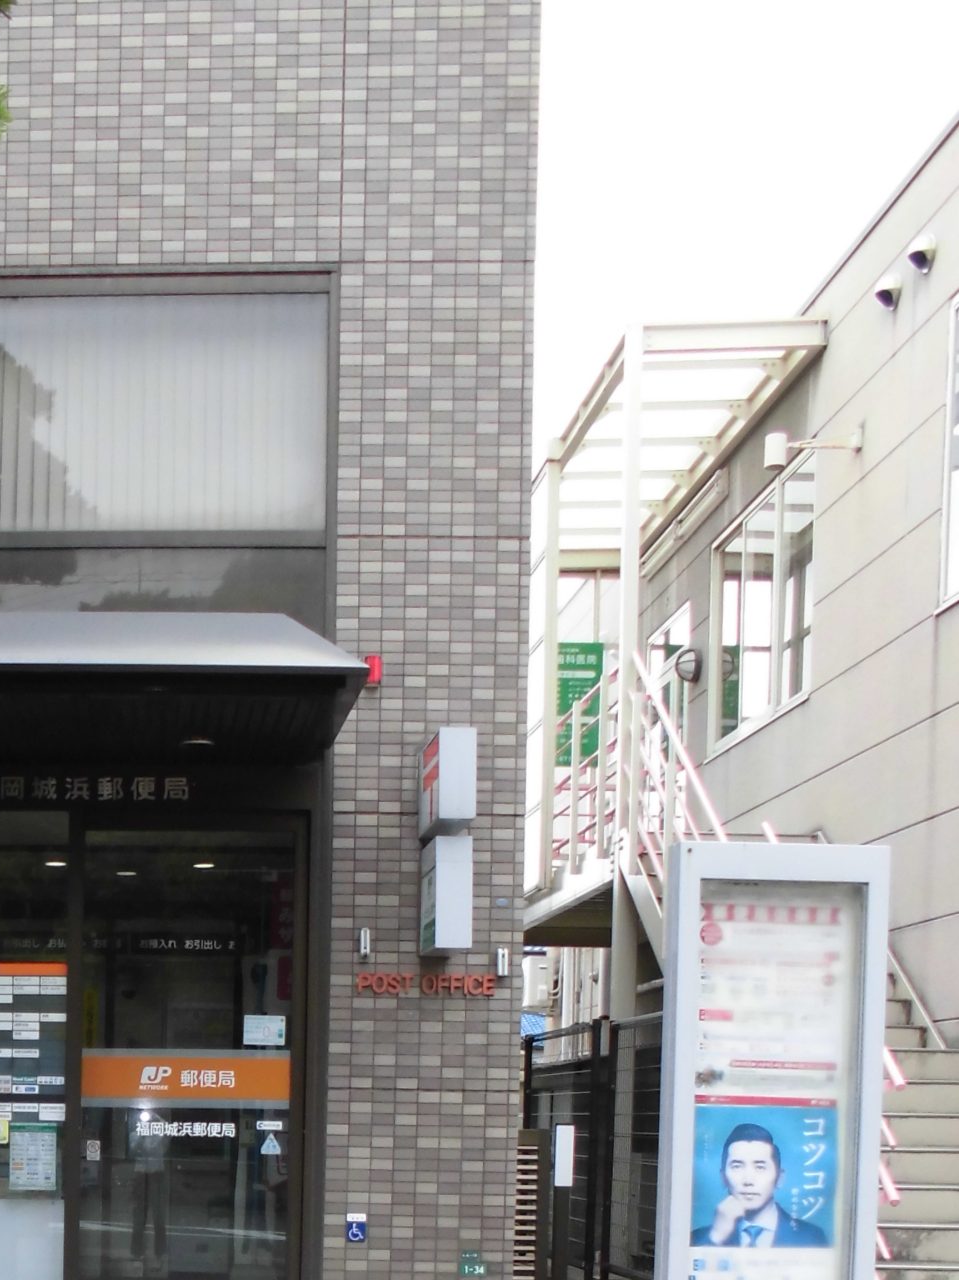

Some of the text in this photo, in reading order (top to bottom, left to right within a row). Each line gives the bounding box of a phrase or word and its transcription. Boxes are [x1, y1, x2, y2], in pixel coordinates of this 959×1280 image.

[184, 938, 222, 950] お引出し
[356, 973, 497, 996] POST OFFICE
[180, 1069, 236, 1088] 郵便局
[135, 1121, 236, 1138] 福岡城浜郵便局
[802, 1117, 826, 1220] コツコツ
[464, 1265, 485, 1275] 1-34
